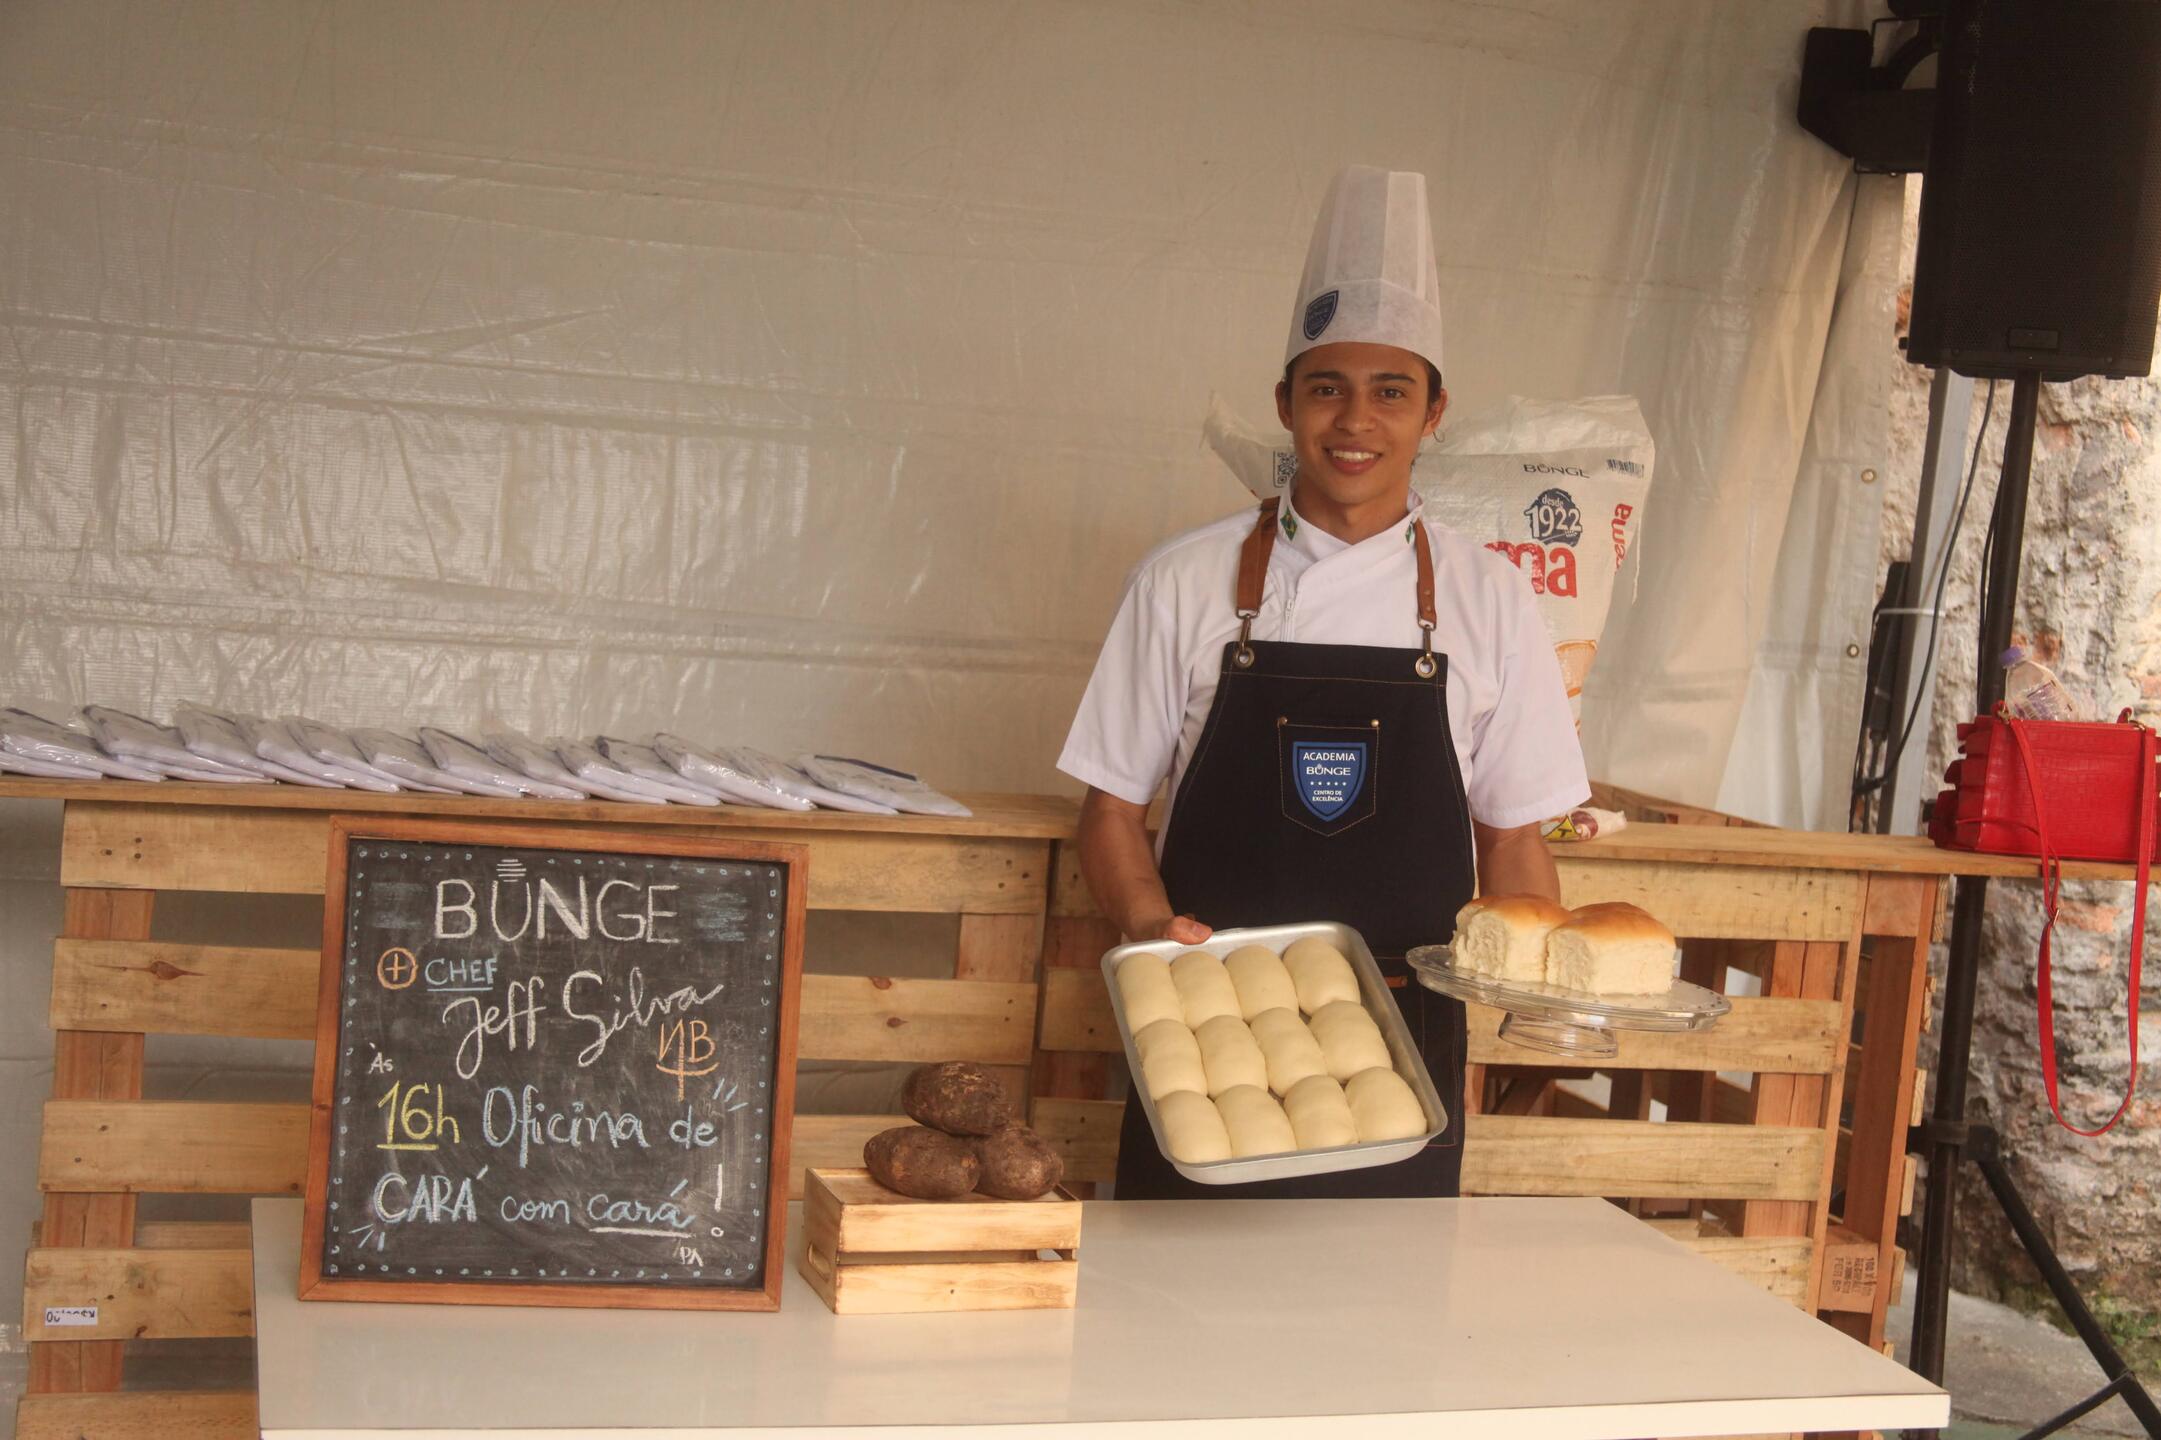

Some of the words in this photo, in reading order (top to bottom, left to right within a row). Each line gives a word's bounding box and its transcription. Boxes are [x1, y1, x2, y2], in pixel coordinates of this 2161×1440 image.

[1524, 505, 1583, 538] 1922
[1303, 752, 1356, 761] ACADEMIA
[1306, 765, 1351, 775] BUNGE
[434, 866, 681, 943] BUNGE
[425, 958, 498, 987] CHEF
[442, 975, 546, 1080] Jeff
[562, 966, 724, 1068] Silva
[377, 1079, 460, 1145] 16h
[482, 1084, 651, 1168] Oficina
[669, 1104, 718, 1150] de
[501, 1195, 570, 1225] com
